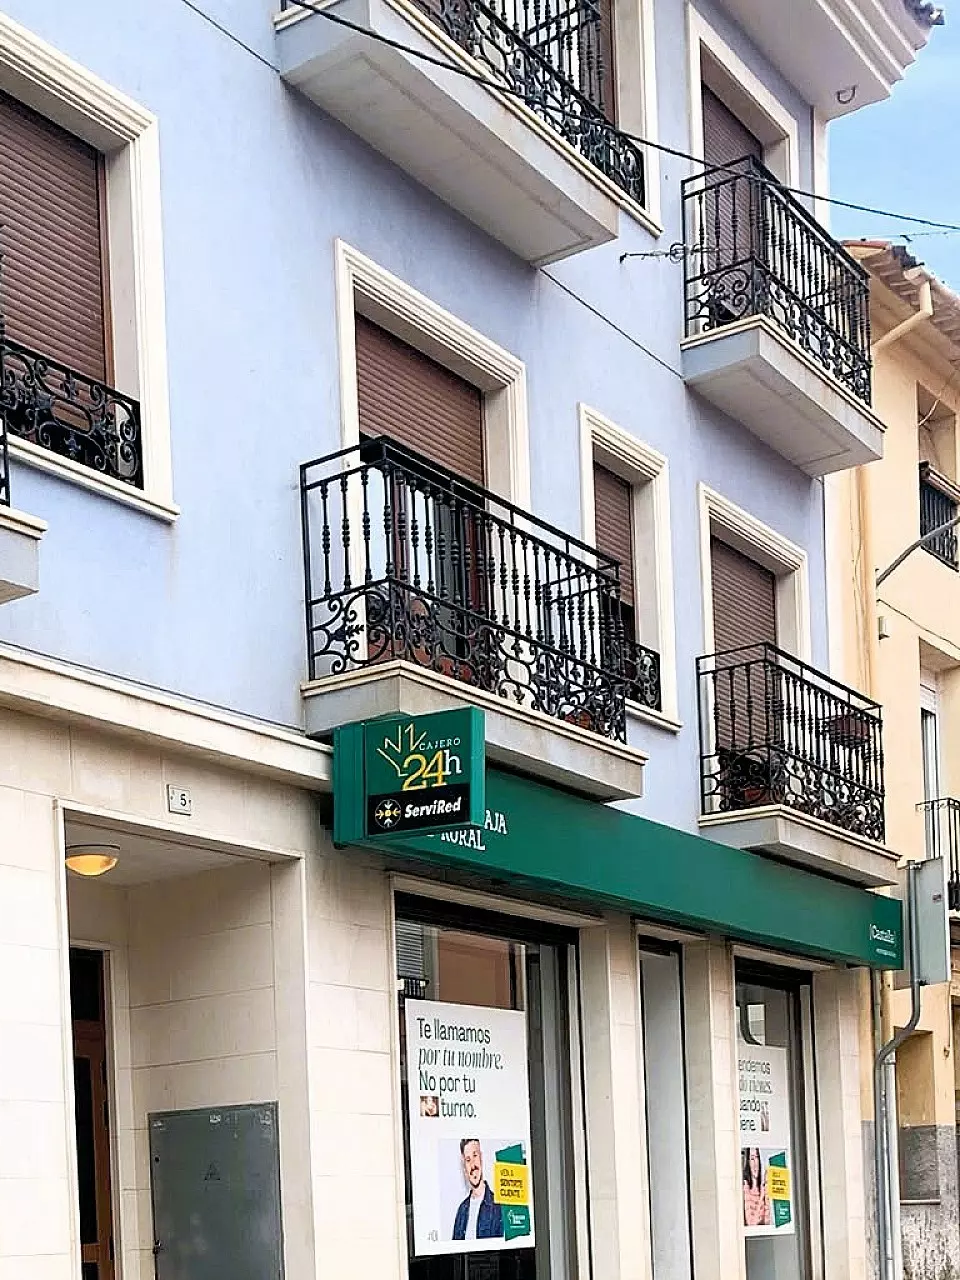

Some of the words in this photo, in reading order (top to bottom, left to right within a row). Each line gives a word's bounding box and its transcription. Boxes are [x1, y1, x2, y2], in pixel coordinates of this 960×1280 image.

[419, 737, 461, 751] CAJERO
[402, 749, 462, 791] 24h
[180, 793, 187, 807] 5
[404, 796, 462, 818] ServiRed
[484, 809, 508, 835] AJA
[416, 1018, 432, 1040] Te
[433, 1018, 491, 1045] llamamos
[418, 1048, 441, 1071] por
[443, 1048, 455, 1067] tu
[458, 1047, 504, 1070] nombre.
[419, 1070, 437, 1091] No
[439, 1076, 460, 1097] por
[461, 1074, 476, 1093] tu
[440, 1099, 477, 1118] turno.
